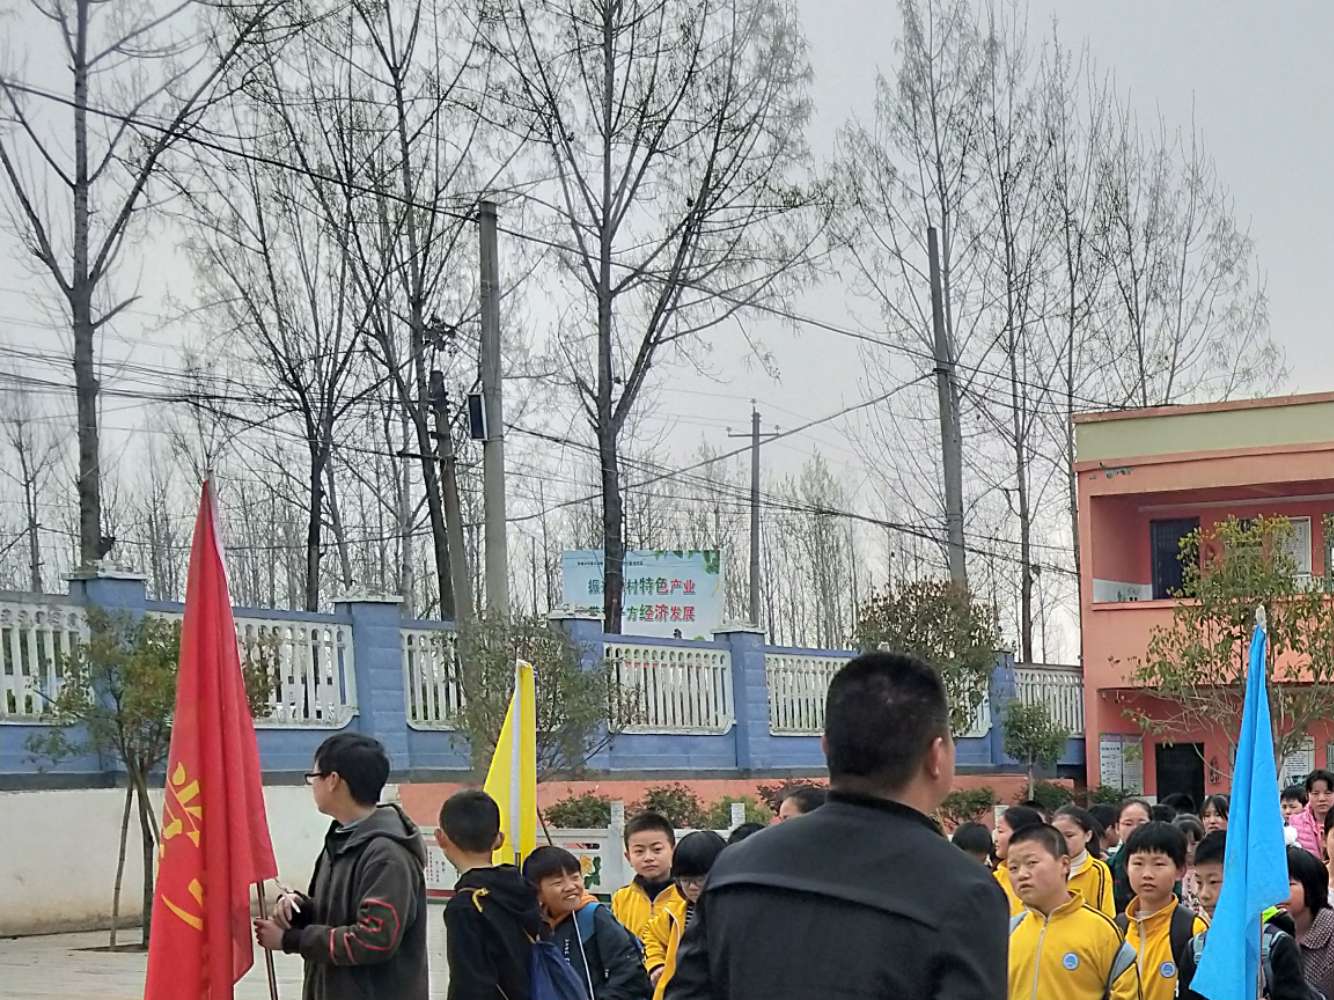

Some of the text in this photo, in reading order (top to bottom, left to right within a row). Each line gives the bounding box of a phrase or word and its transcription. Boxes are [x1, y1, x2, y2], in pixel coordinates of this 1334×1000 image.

[588, 577, 696, 596] 振村特色产业
